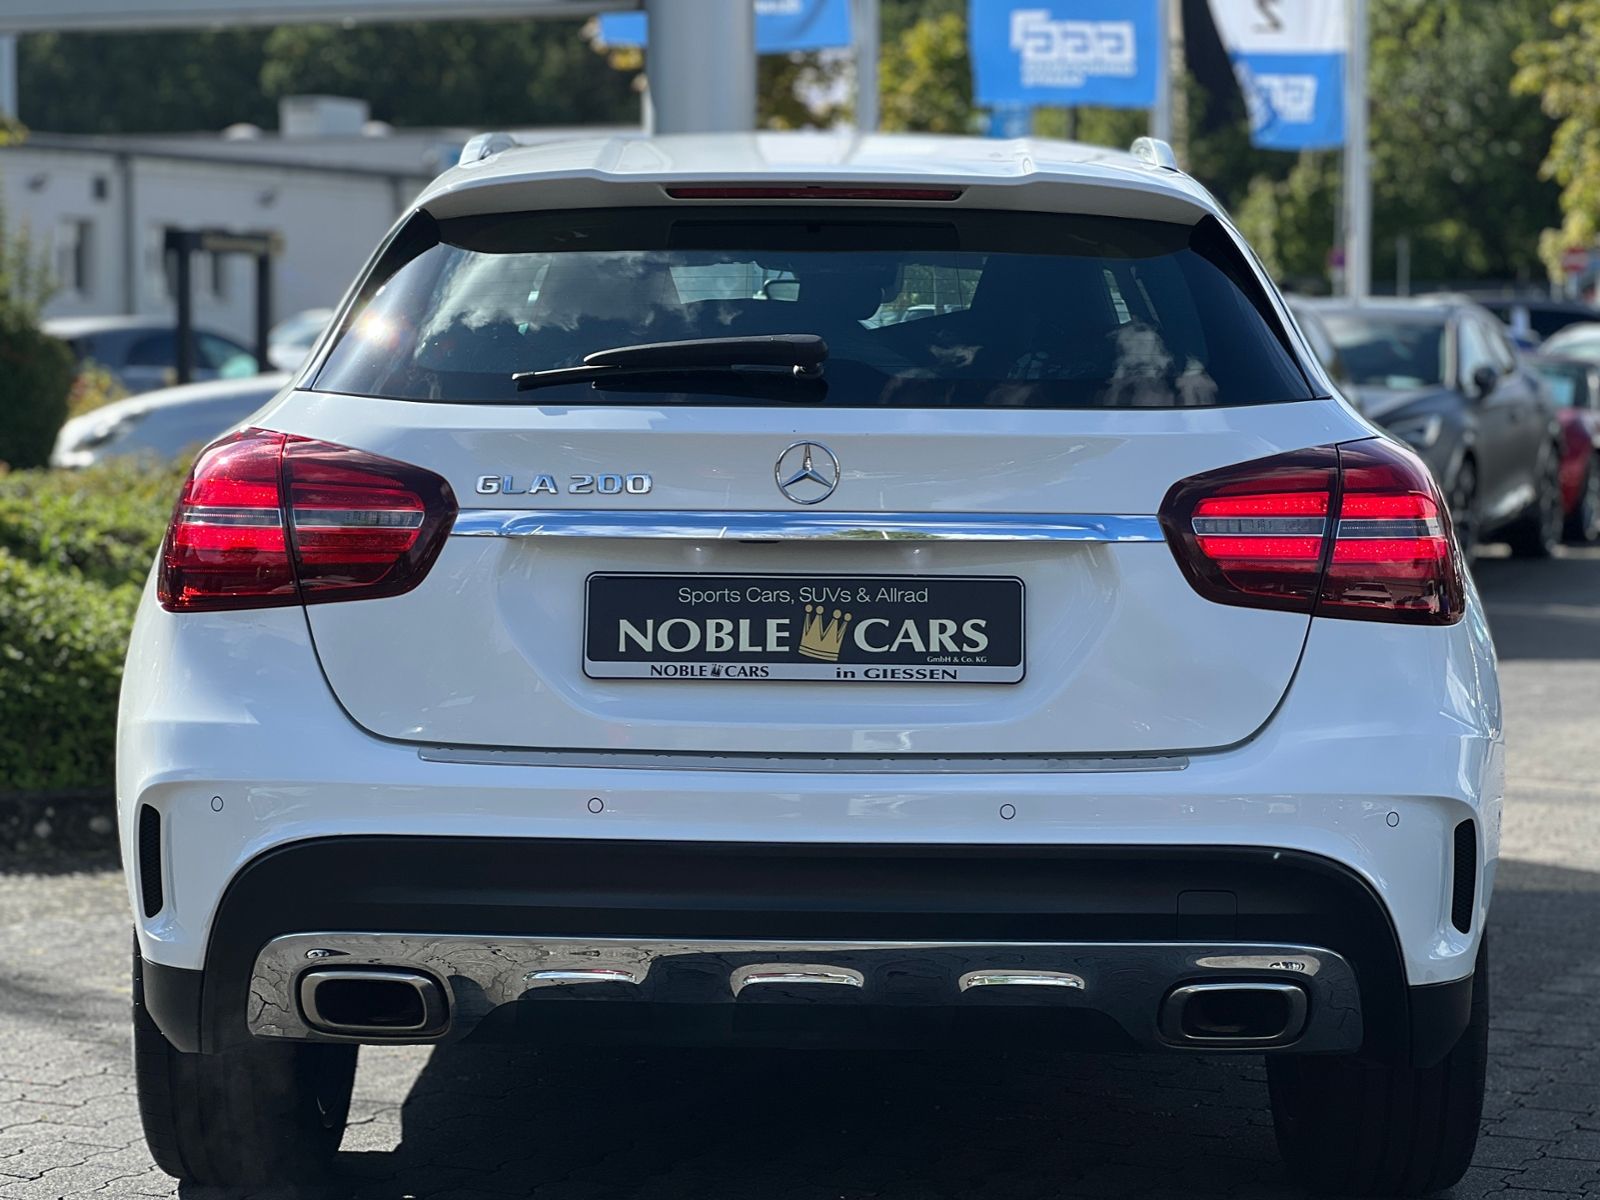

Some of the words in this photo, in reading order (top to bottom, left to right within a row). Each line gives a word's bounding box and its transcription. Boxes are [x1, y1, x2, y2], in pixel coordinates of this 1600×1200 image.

[476, 474, 559, 495] GLA
[567, 473, 653, 495] 200
[678, 587, 741, 606] Sports
[746, 587, 795, 604] Cars,
[799, 586, 852, 603] SUVs
[856, 587, 871, 603] &
[875, 587, 929, 603] Allrad
[618, 618, 791, 653] NOBLE
[853, 618, 989, 653] CARS
[927, 655, 951, 663] GmbH
[650, 664, 708, 677] NOBLE
[724, 665, 770, 678] CARS
[836, 667, 856, 679] in
[863, 668, 958, 680] GIESSEN
